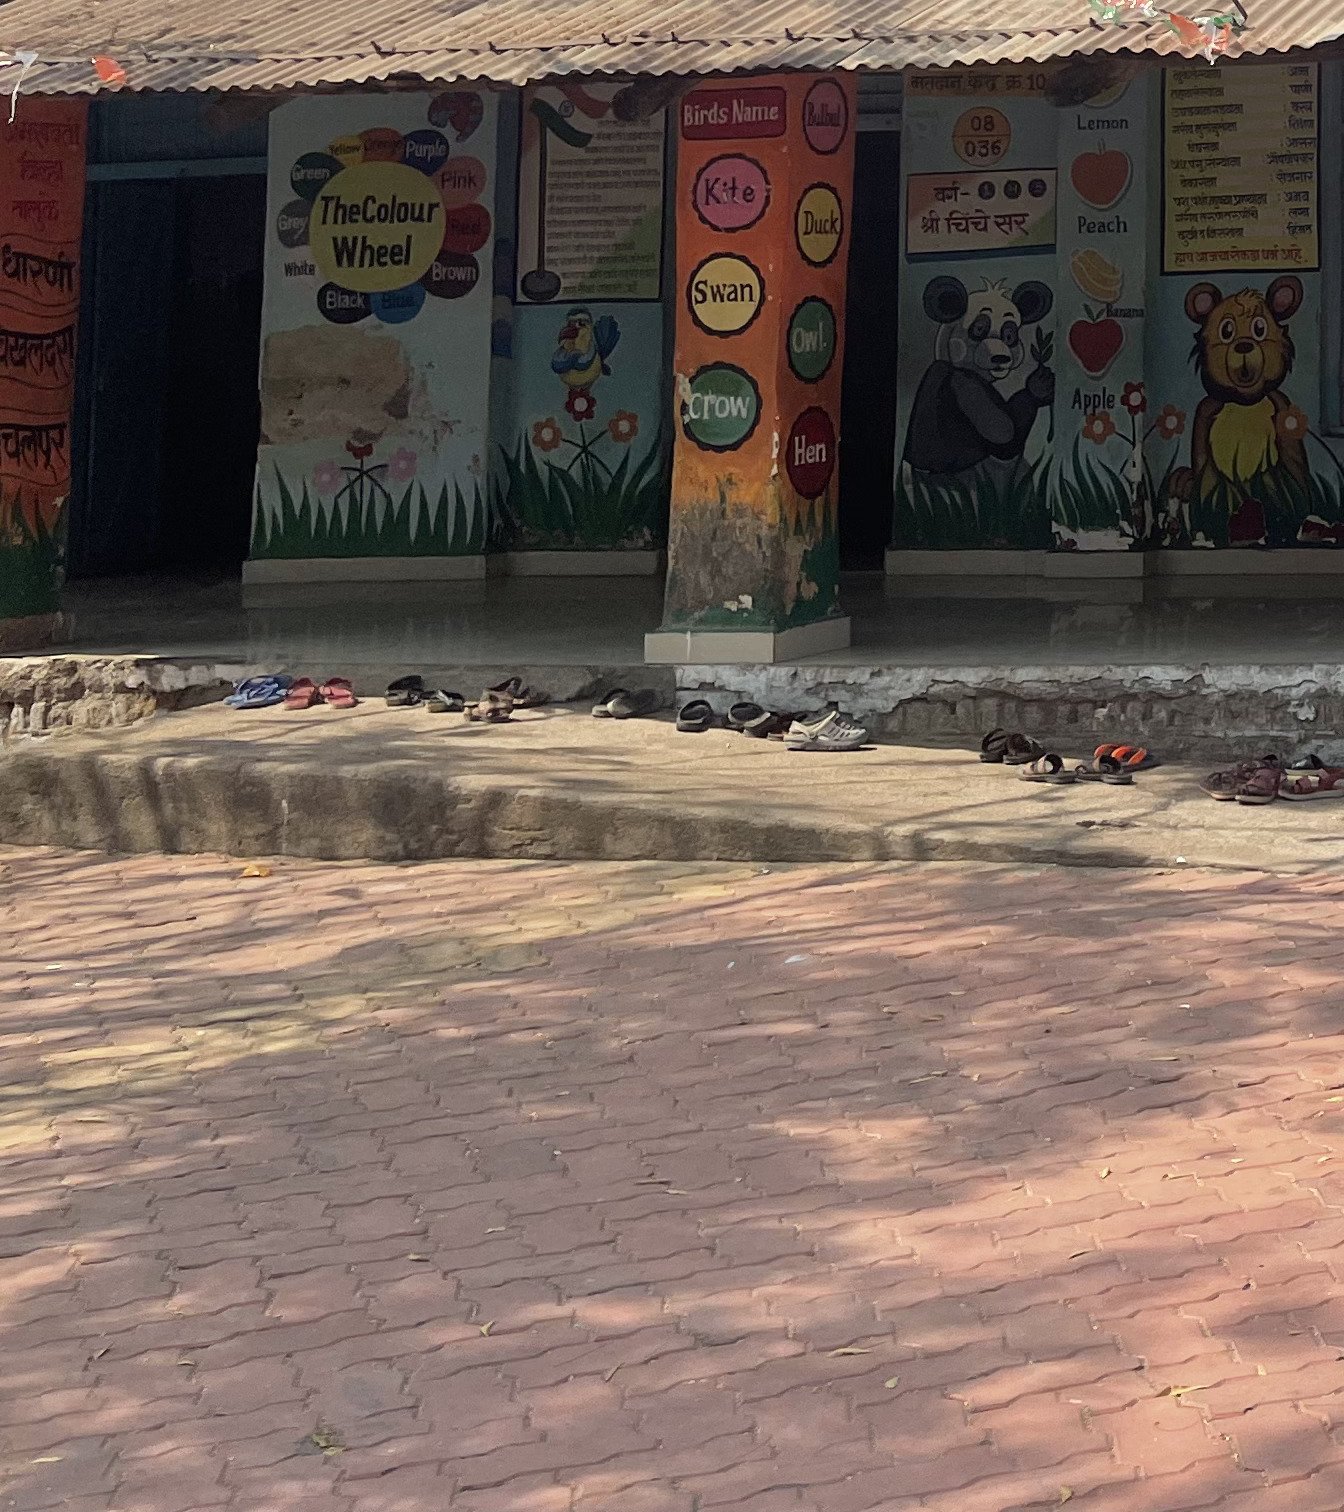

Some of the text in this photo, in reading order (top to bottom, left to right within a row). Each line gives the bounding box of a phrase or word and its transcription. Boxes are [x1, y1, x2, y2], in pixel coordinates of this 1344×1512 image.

[1026, 73, 1046, 90] 10
[684, 99, 779, 126] Birds Name
[1077, 114, 1128, 129] Lemon
[971, 115, 995, 133] 08
[405, 139, 447, 162] Purple
[964, 139, 1001, 157] 036
[291, 164, 330, 179] Green
[441, 172, 478, 189] Pink
[704, 178, 755, 206] Kite
[803, 210, 839, 236] Duck
[995, 212, 1029, 235] सर
[1078, 215, 1128, 233] Peach
[332, 235, 412, 268] Wheel
[284, 261, 315, 277] White
[432, 263, 477, 281] Brown
[325, 291, 365, 309] Black
[694, 282, 754, 305] Swan
[1072, 389, 1115, 411] Apple
[794, 436, 826, 467] Hen
